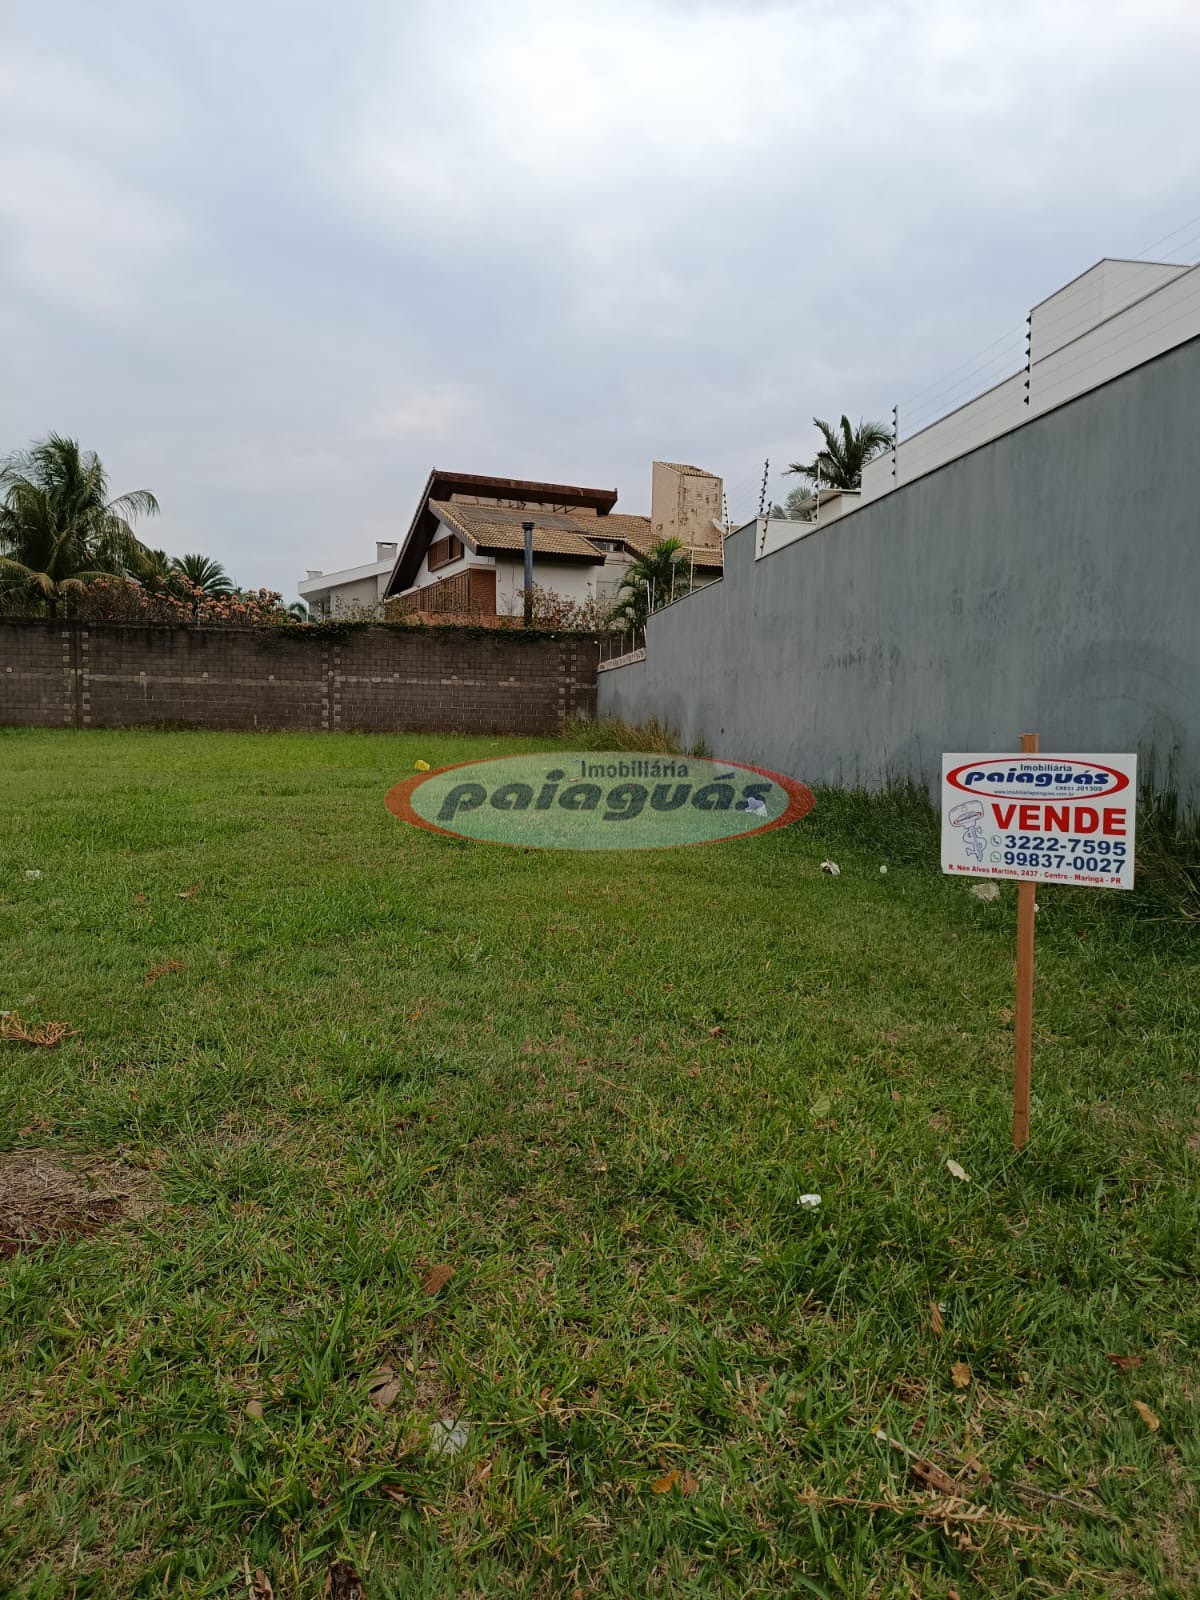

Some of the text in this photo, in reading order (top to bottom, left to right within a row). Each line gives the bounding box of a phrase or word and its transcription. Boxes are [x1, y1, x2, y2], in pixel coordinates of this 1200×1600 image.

[965, 768, 1110, 787] paiaguás
[1020, 763, 1072, 772] Imobiliária
[991, 803, 1127, 836] VENDE
[1004, 835, 1127, 856] 3222-7595
[1004, 851, 1126, 874] 99837-0027
[1021, 869, 1038, 877] 2437
[1044, 871, 1068, 880] Centro
[1074, 874, 1104, 883] Maringá
[1110, 877, 1121, 885] PR
